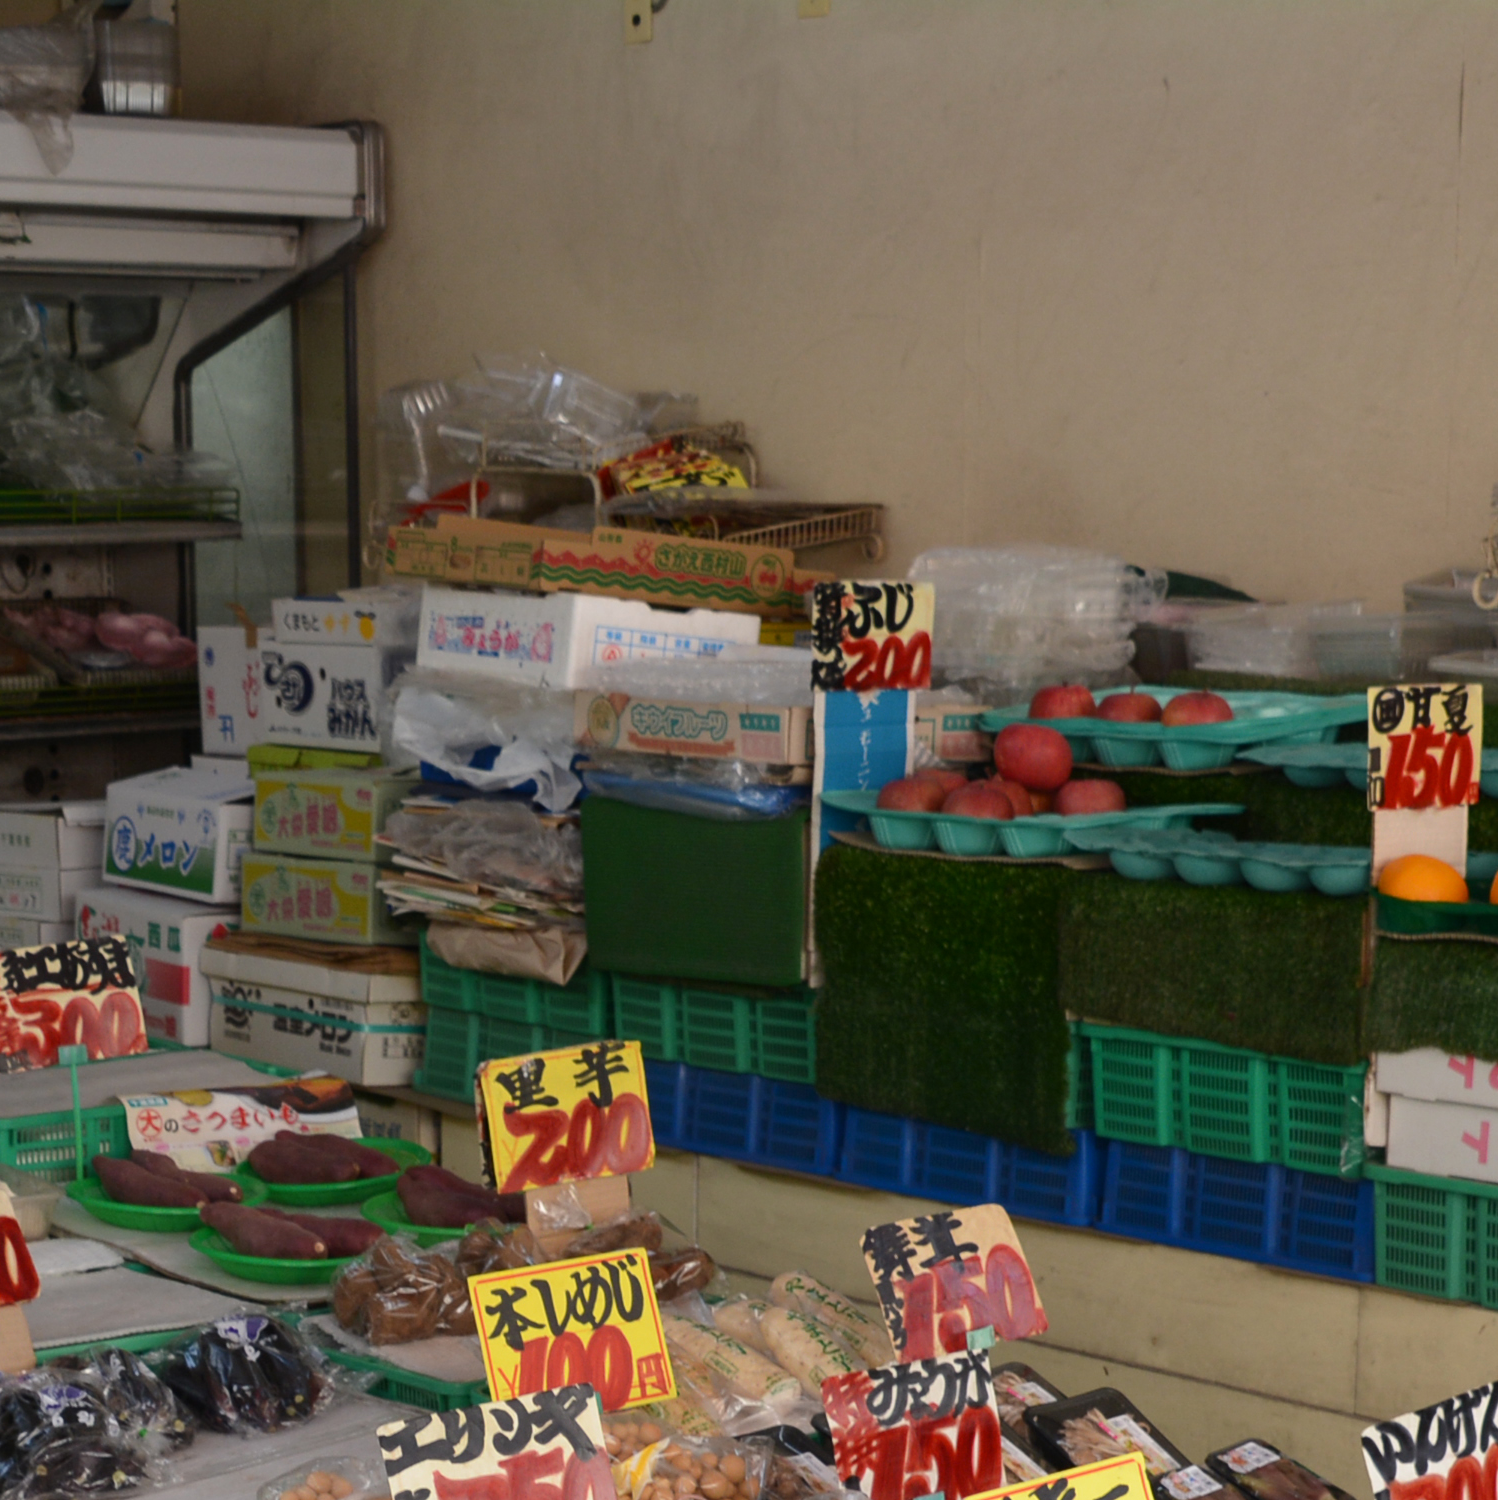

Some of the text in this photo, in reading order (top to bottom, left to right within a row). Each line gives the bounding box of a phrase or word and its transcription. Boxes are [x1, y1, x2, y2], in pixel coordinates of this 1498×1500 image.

[283, 611, 321, 632] くまもと
[850, 581, 914, 638] ふじ
[841, 630, 932, 691] 200
[631, 704, 729, 741] キウイフルーツ
[1378, 725, 1473, 811] 150
[137, 832, 201, 877] メロン
[4, 992, 142, 1062] 300
[502, 1093, 652, 1194] 200
[485, 1254, 646, 1351] 本しめじ
[892, 1243, 1038, 1364] 150
[377, 1383, 599, 1478] エリンギ
